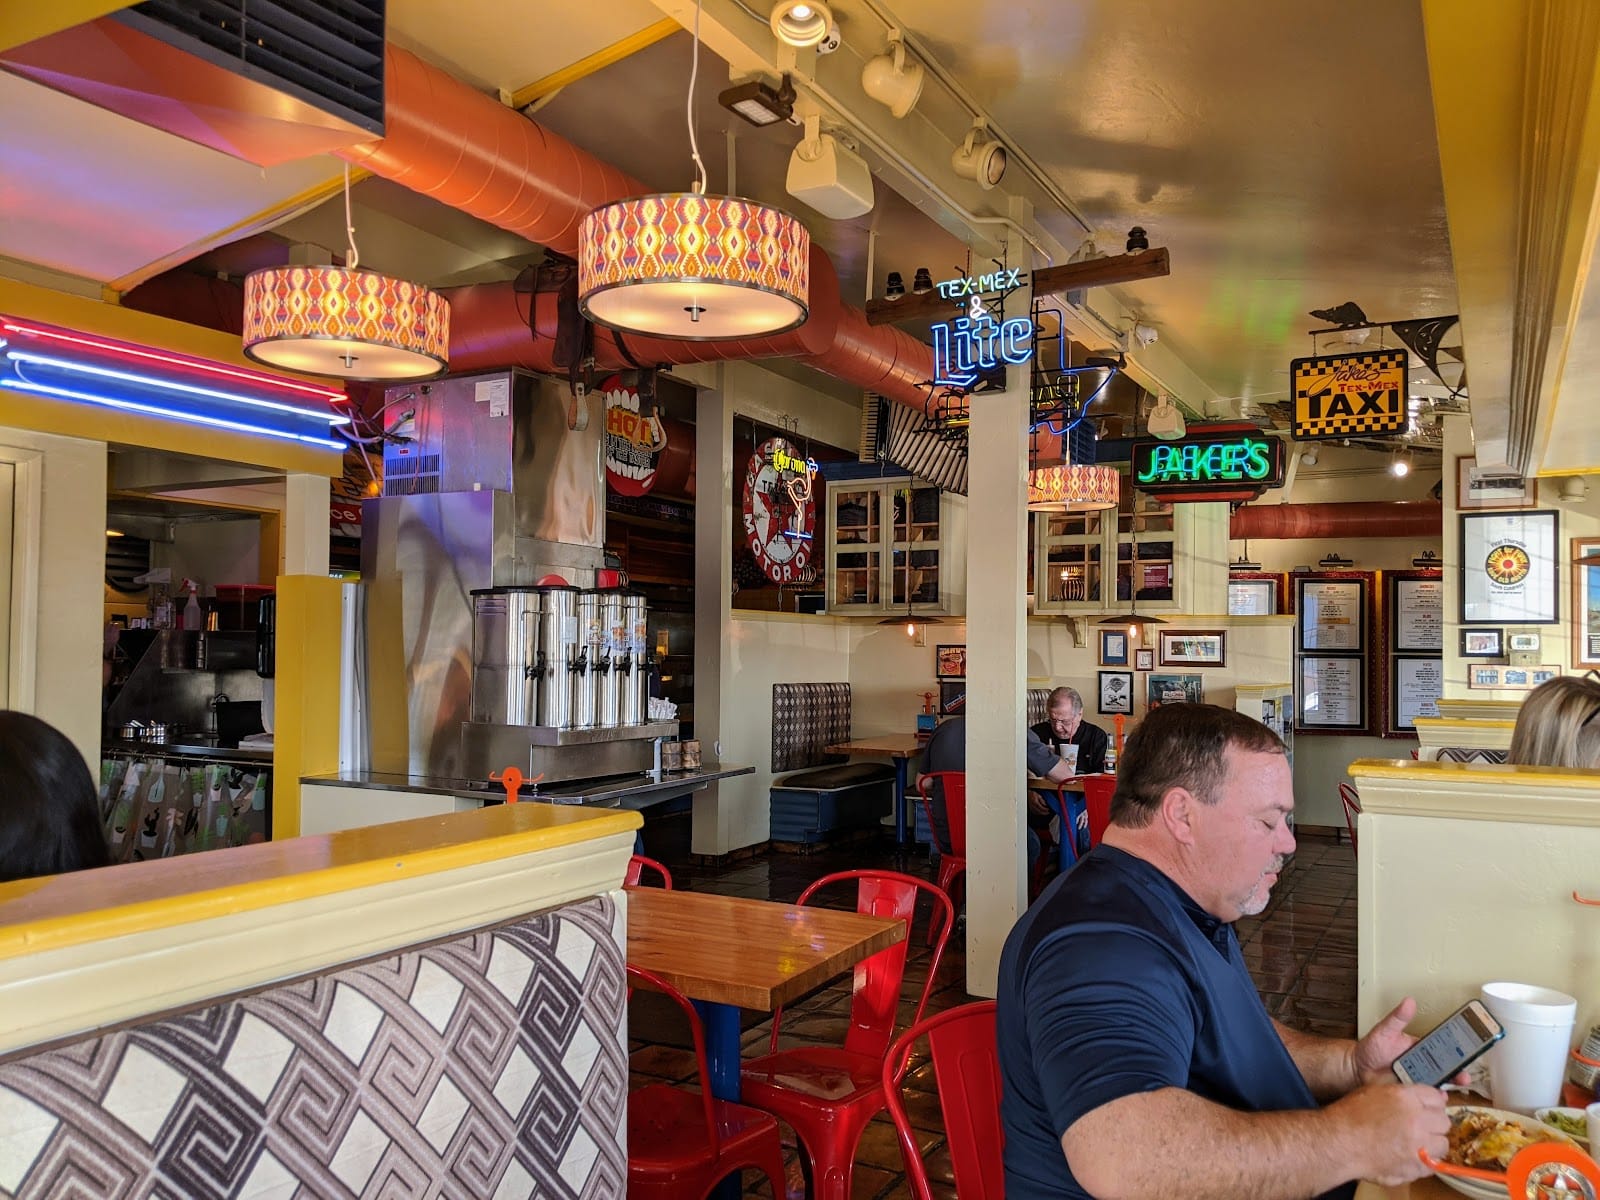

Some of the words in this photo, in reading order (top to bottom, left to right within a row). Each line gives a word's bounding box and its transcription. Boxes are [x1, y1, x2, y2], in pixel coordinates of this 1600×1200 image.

[936, 268, 1020, 299] TEX-MEX
[969, 296, 987, 319] &
[931, 315, 1033, 386] Lite
[1298, 389, 1399, 419] TAXI
[773, 448, 806, 473] Corona
[1138, 438, 1269, 482] JAKE'S
[743, 513, 793, 581] MOTOR
